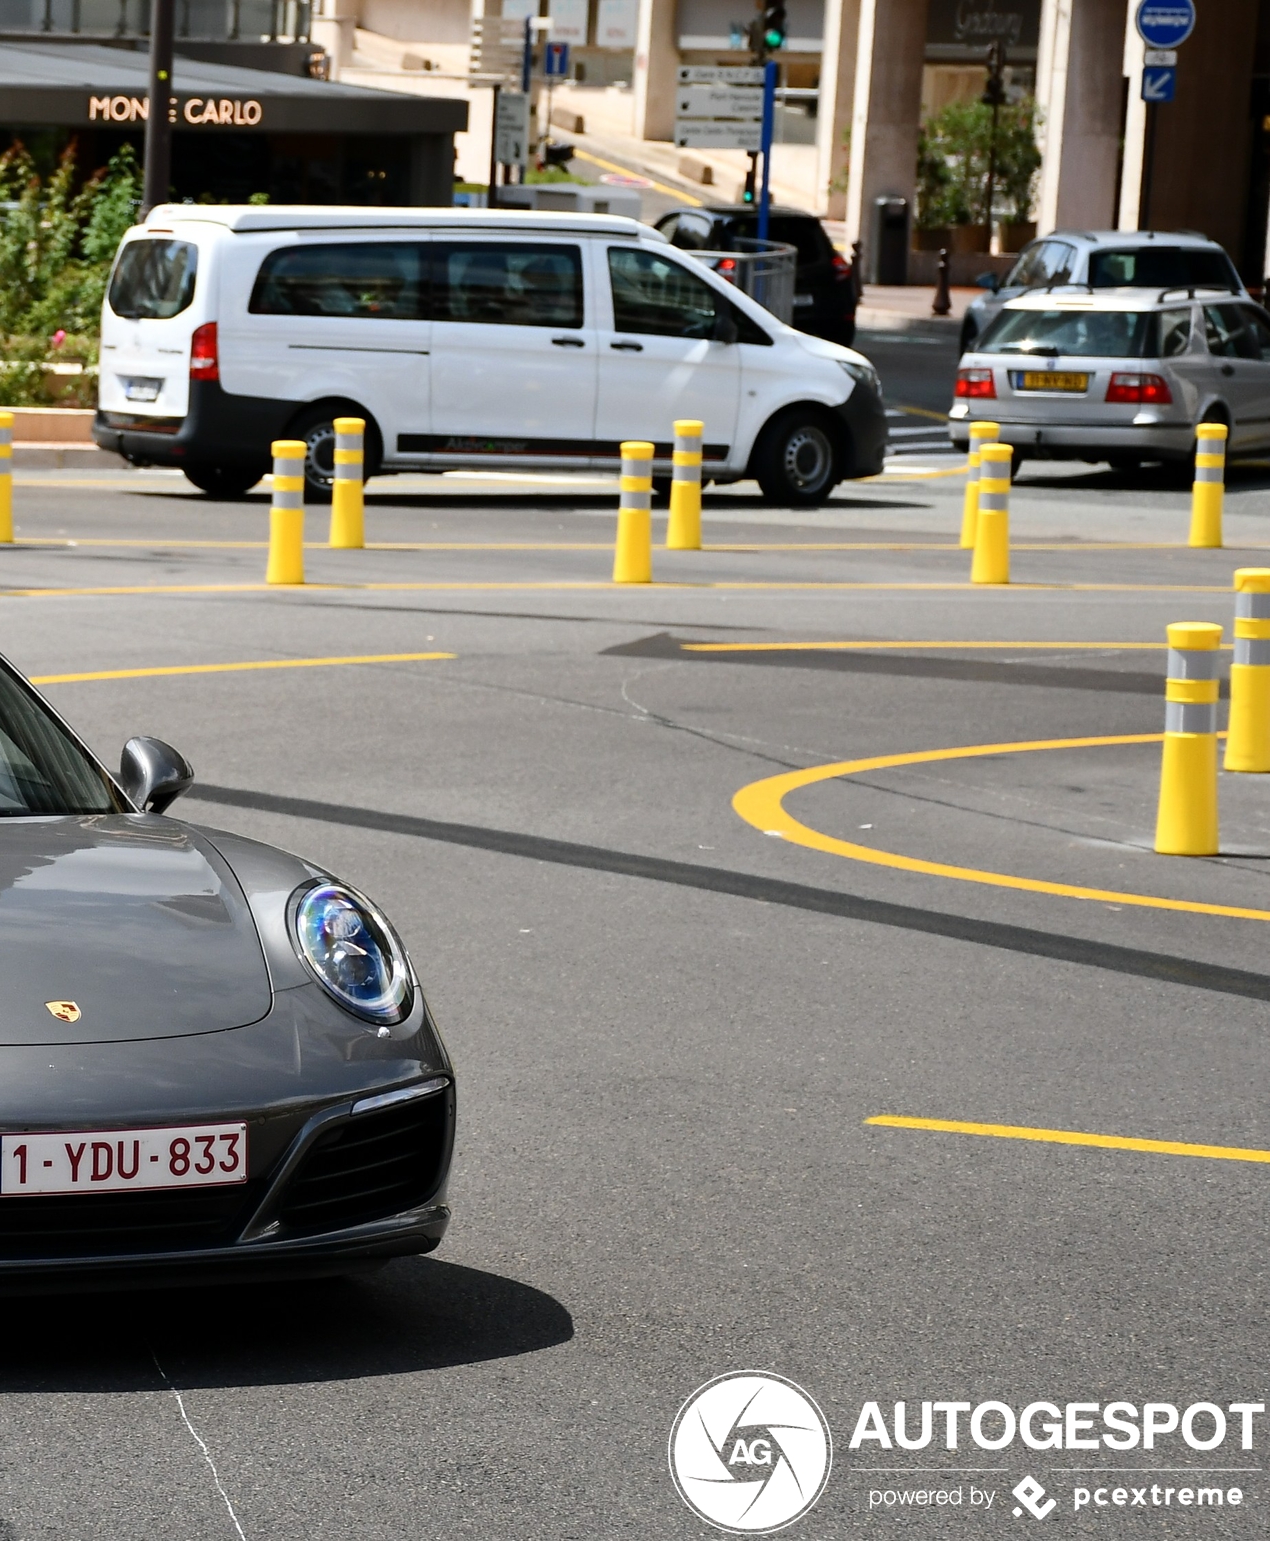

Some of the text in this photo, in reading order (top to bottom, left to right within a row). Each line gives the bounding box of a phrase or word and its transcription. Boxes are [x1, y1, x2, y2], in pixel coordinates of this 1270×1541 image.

[89, 95, 263, 126] MON CARLO
[12, 1133, 240, 1185] 1-YDU-833
